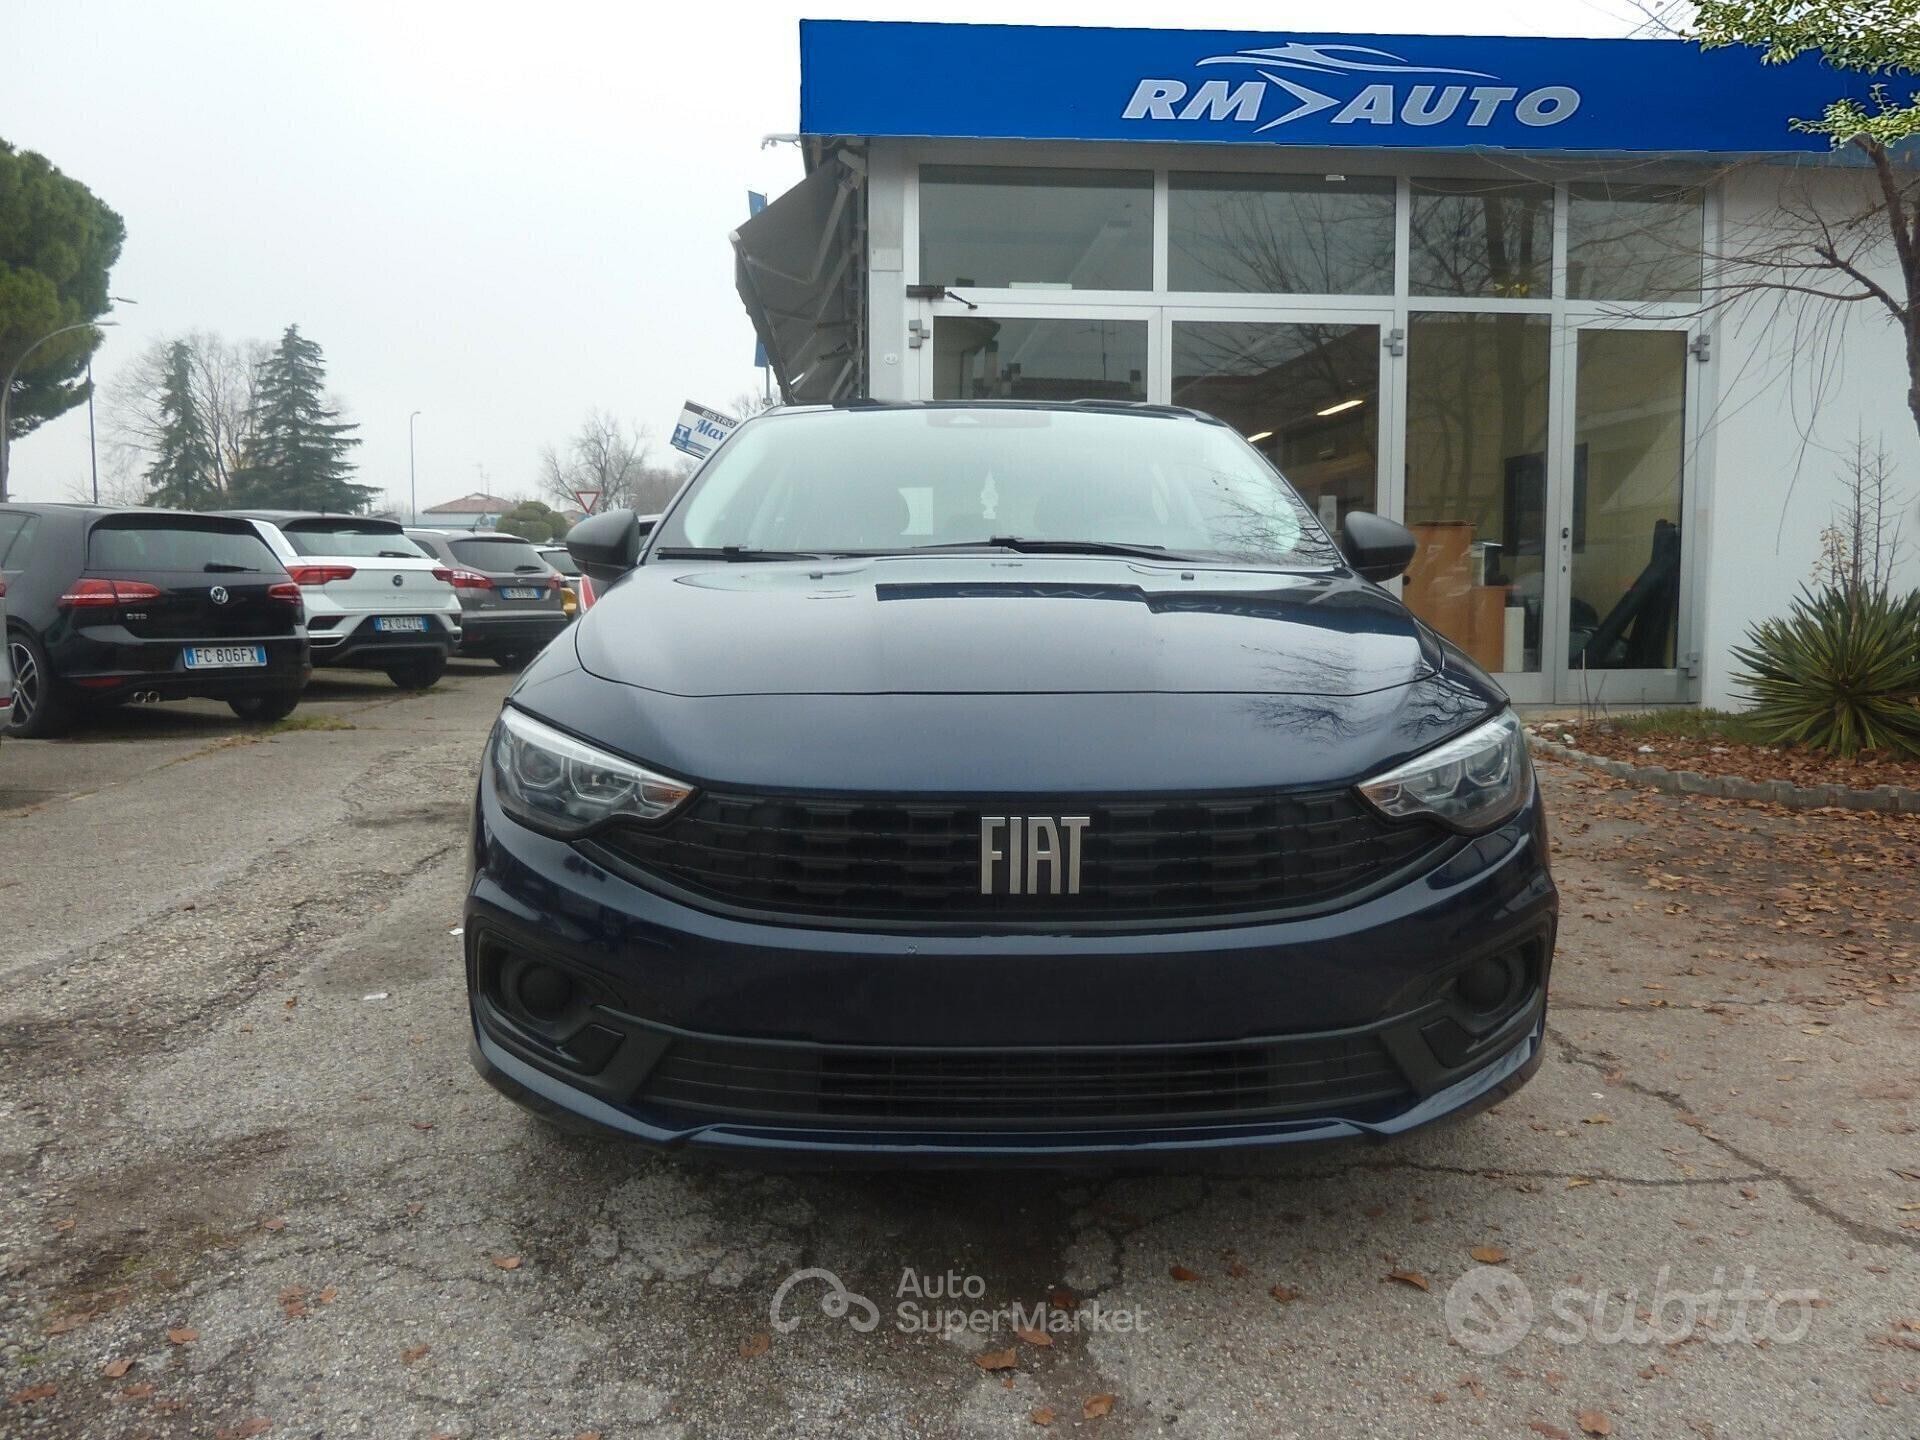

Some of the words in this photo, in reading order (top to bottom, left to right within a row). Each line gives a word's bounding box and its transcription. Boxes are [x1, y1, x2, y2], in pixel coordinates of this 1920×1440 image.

[1121, 79, 1266, 122] RM
[1330, 85, 1581, 127] AUTO
[217, 648, 257, 663] 806FX
[981, 816, 1091, 895] FIAT
